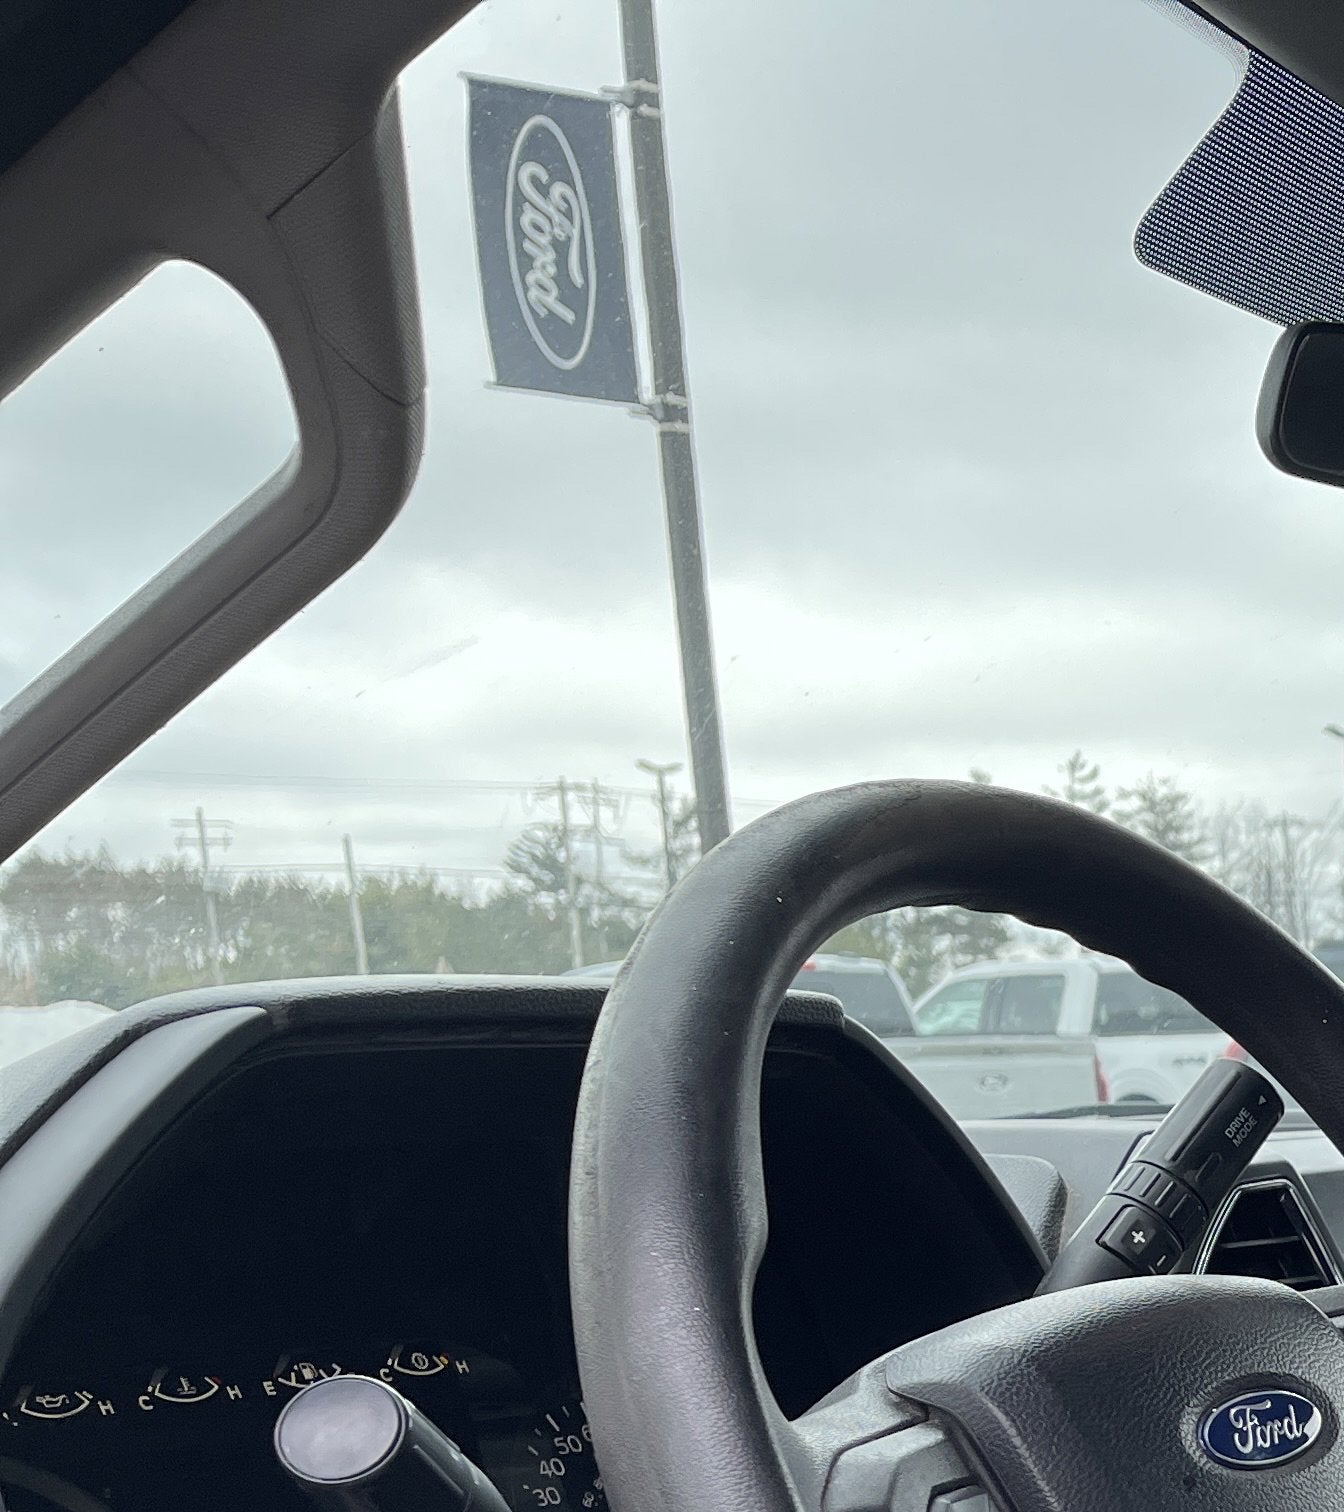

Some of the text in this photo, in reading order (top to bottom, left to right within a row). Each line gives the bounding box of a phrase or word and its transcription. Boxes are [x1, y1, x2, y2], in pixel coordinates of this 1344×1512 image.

[517, 160, 584, 326] Ford
[1224, 1107, 1252, 1140] DRIVE
[1231, 1114, 1258, 1148] MODE
[379, 1360, 470, 1382] C H
[138, 1385, 243, 1412] C H
[264, 1381, 277, 1396] E
[97, 1400, 115, 1416] H
[1229, 1398, 1306, 1455] Ford
[553, 1434, 583, 1455] 50
[539, 1457, 566, 1478] 40
[531, 1486, 562, 1508] 30
